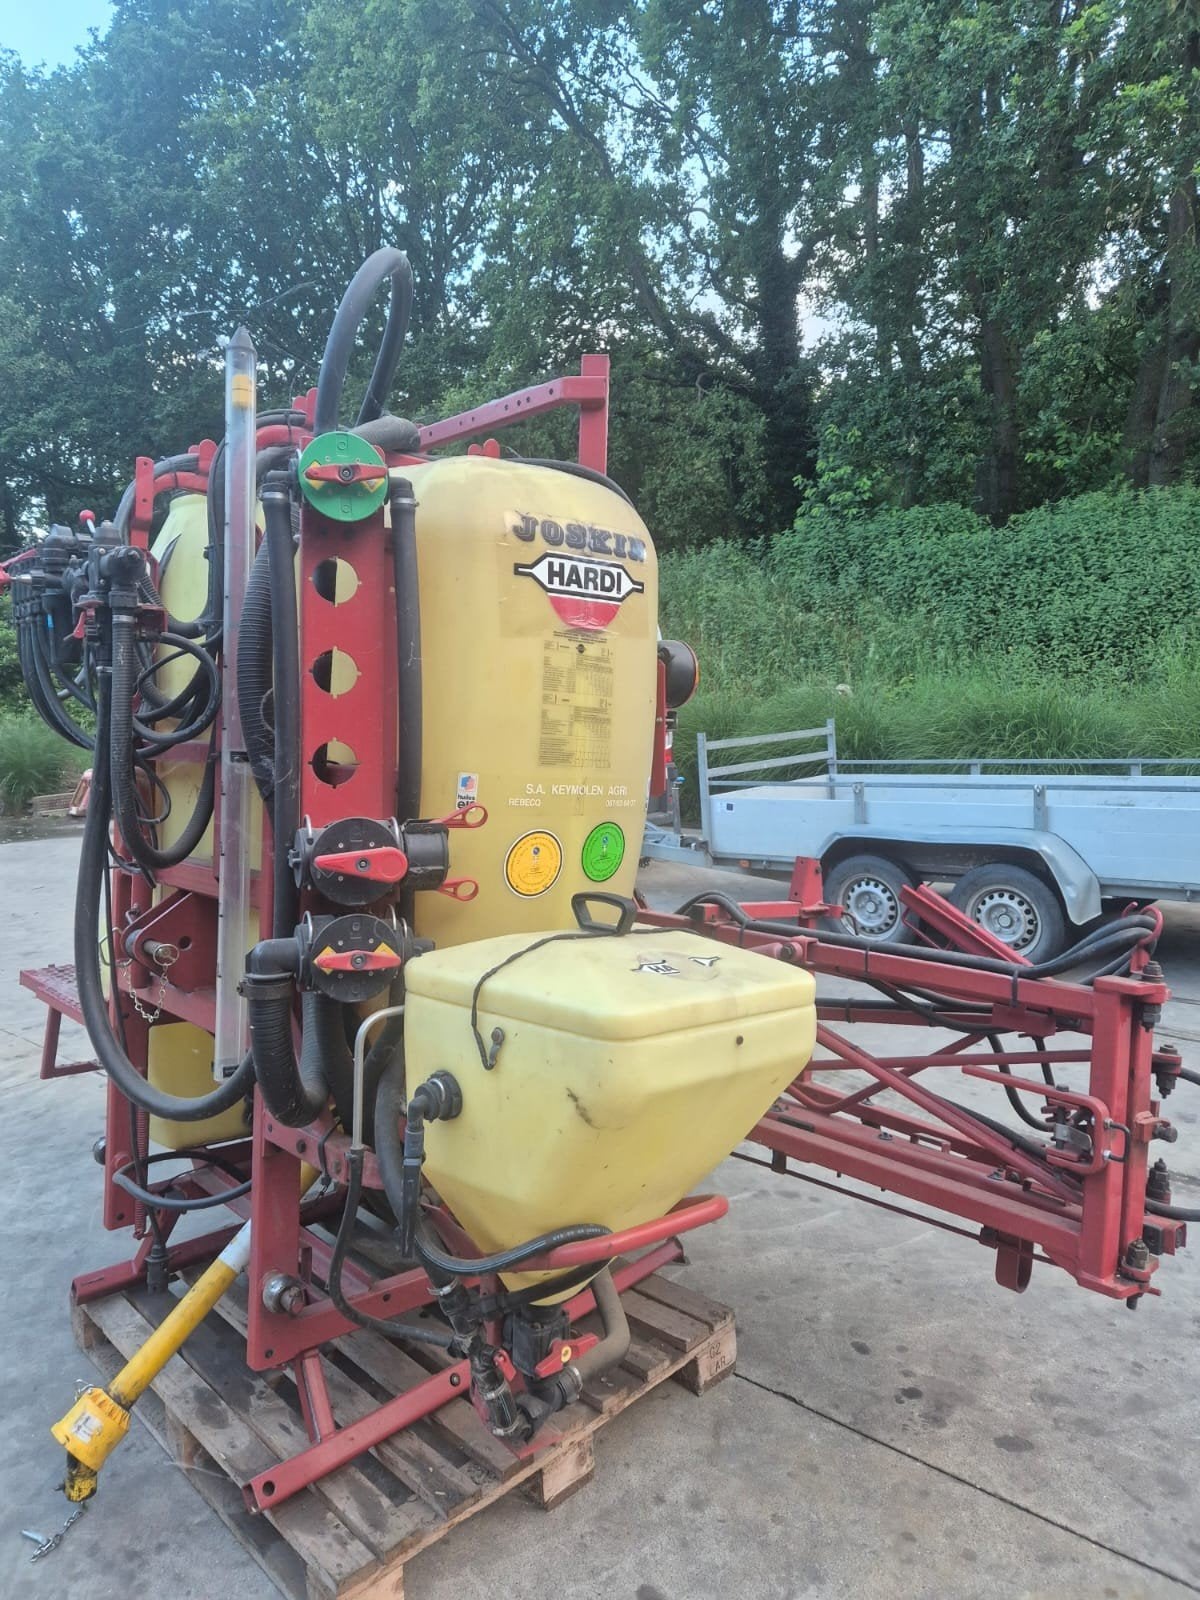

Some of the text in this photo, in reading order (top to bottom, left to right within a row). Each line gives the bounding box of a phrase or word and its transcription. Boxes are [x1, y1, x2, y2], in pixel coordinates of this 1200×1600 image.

[547, 560, 622, 595] HARDI
[526, 783, 627, 796] S.A. KEYMOLEN AGRI
